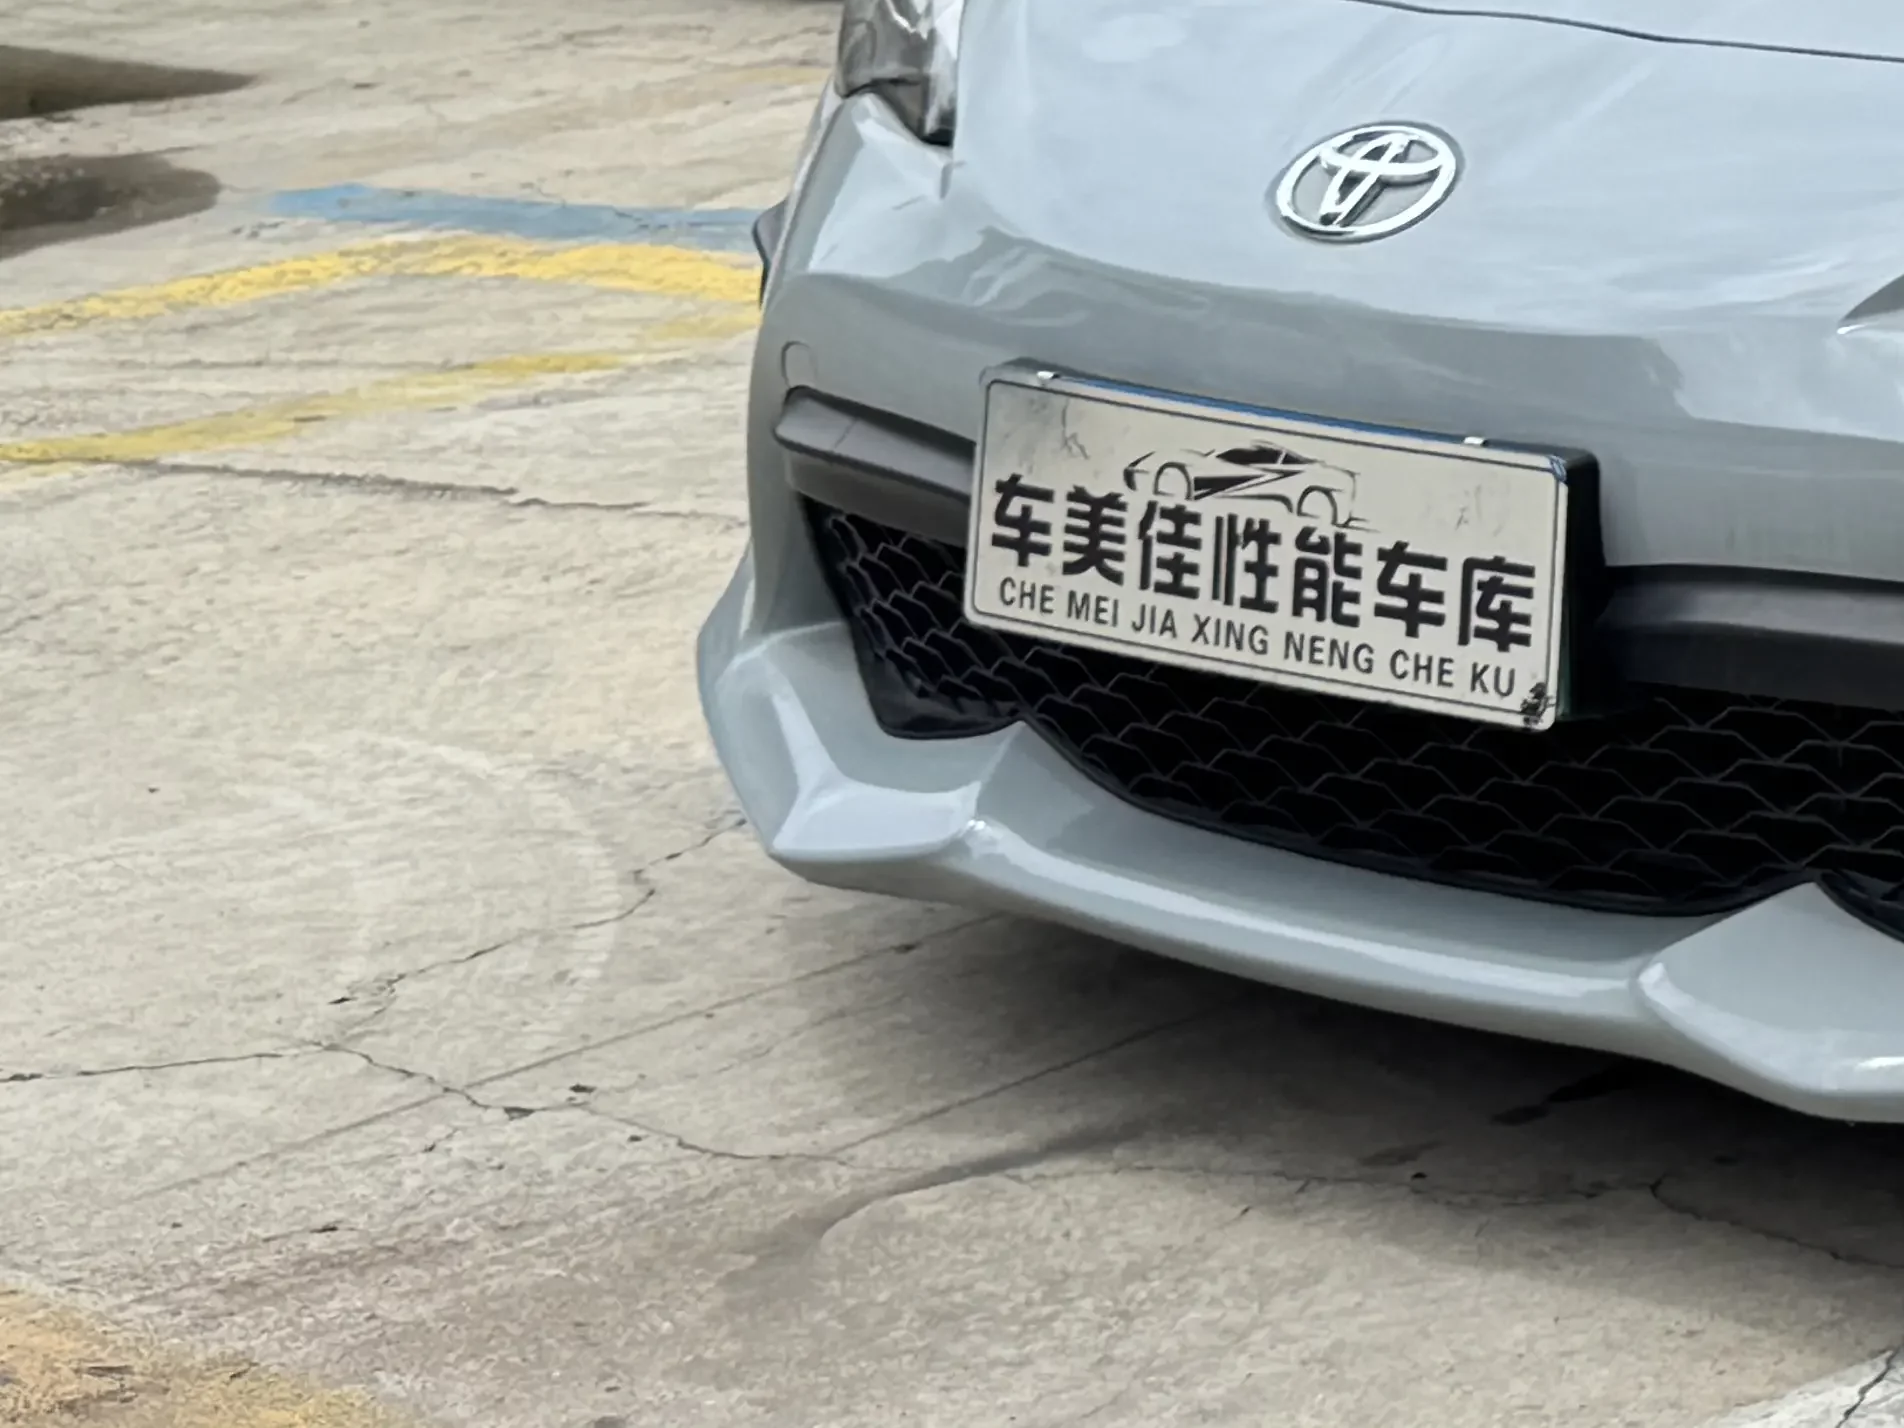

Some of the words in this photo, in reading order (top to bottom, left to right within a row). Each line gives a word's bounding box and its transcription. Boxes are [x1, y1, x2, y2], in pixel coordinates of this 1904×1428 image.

[991, 473, 1536, 652] 车美佳性能车库
[999, 576, 1055, 614] CHE
[1067, 589, 1119, 627] MEI
[1131, 603, 1178, 639] JIA
[1191, 613, 1269, 656] XING
[1283, 630, 1375, 675] NENG
[1389, 648, 1455, 688] CHE
[1469, 661, 1516, 697] KU
